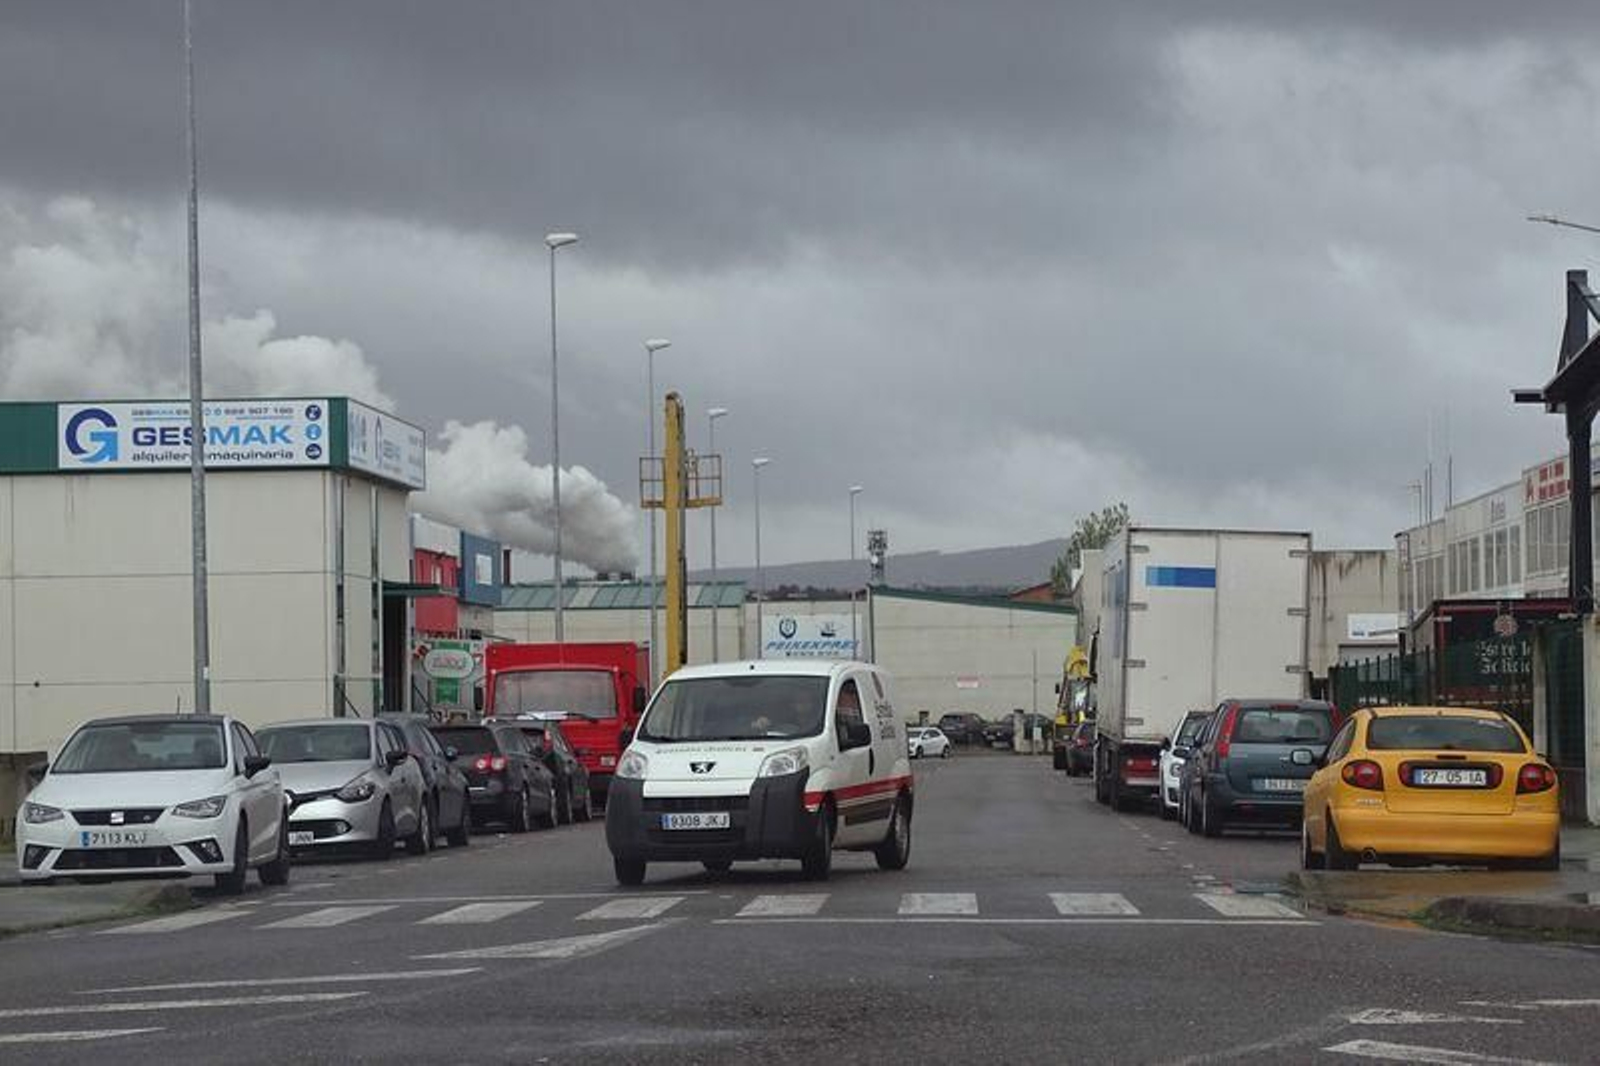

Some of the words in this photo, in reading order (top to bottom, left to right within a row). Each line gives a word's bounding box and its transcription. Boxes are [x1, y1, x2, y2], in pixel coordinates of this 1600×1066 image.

[132, 425, 293, 446] GESMAK
[132, 450, 190, 463] alquiler
[208, 449, 294, 462] maquinaria
[671, 815, 701, 827] 9308
[704, 814, 727, 826] JKJ
[92, 833, 122, 844] 7113
